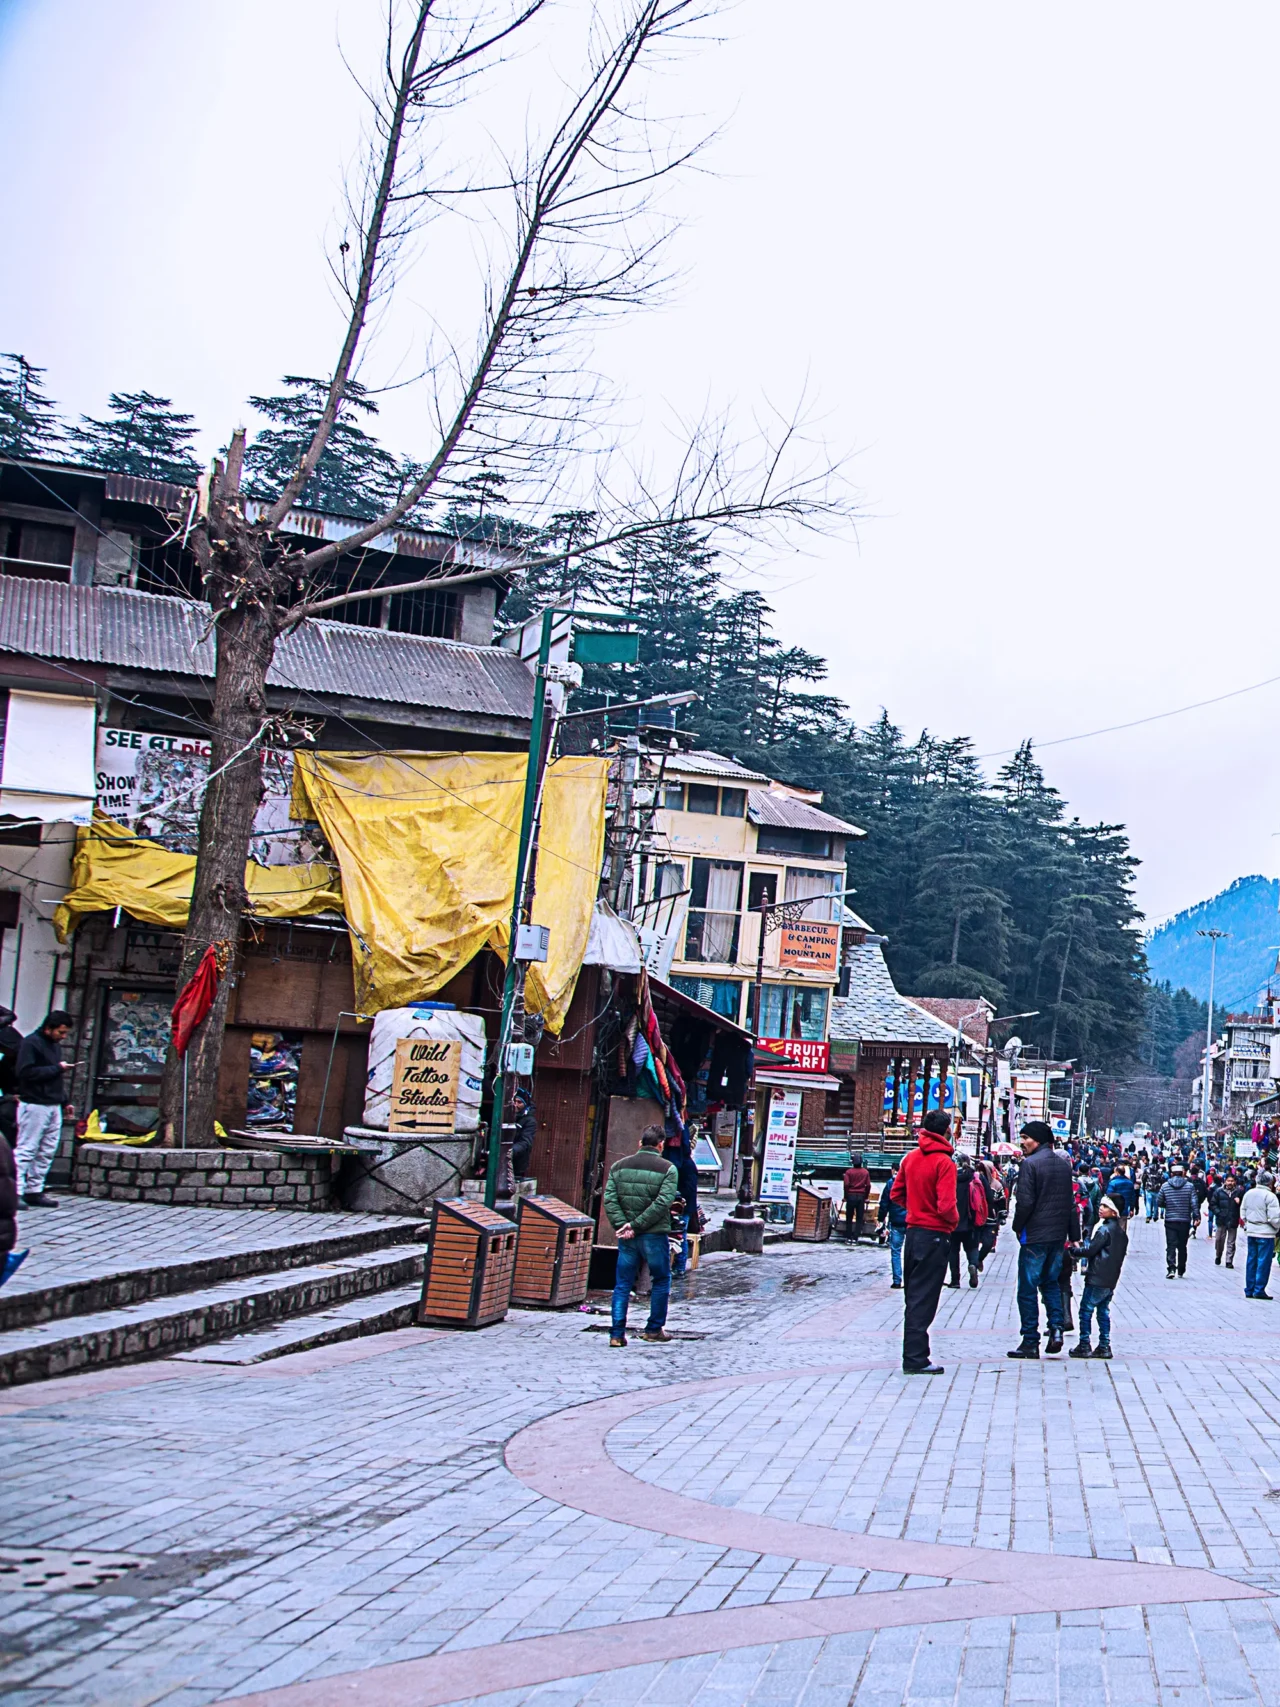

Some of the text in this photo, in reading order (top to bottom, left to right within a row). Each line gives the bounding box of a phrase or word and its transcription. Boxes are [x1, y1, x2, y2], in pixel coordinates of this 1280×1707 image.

[106, 730, 142, 750] SEE
[782, 922, 829, 935] BARBECUE
[796, 935, 837, 945] CAMPING
[783, 948, 831, 959] MOUNTAIN
[410, 1043, 451, 1062] Wild
[785, 1043, 825, 1056] FRUIT
[402, 1066, 450, 1084] Tattoo
[399, 1088, 450, 1106] Studio
[934, 1087, 950, 1098] Jo
